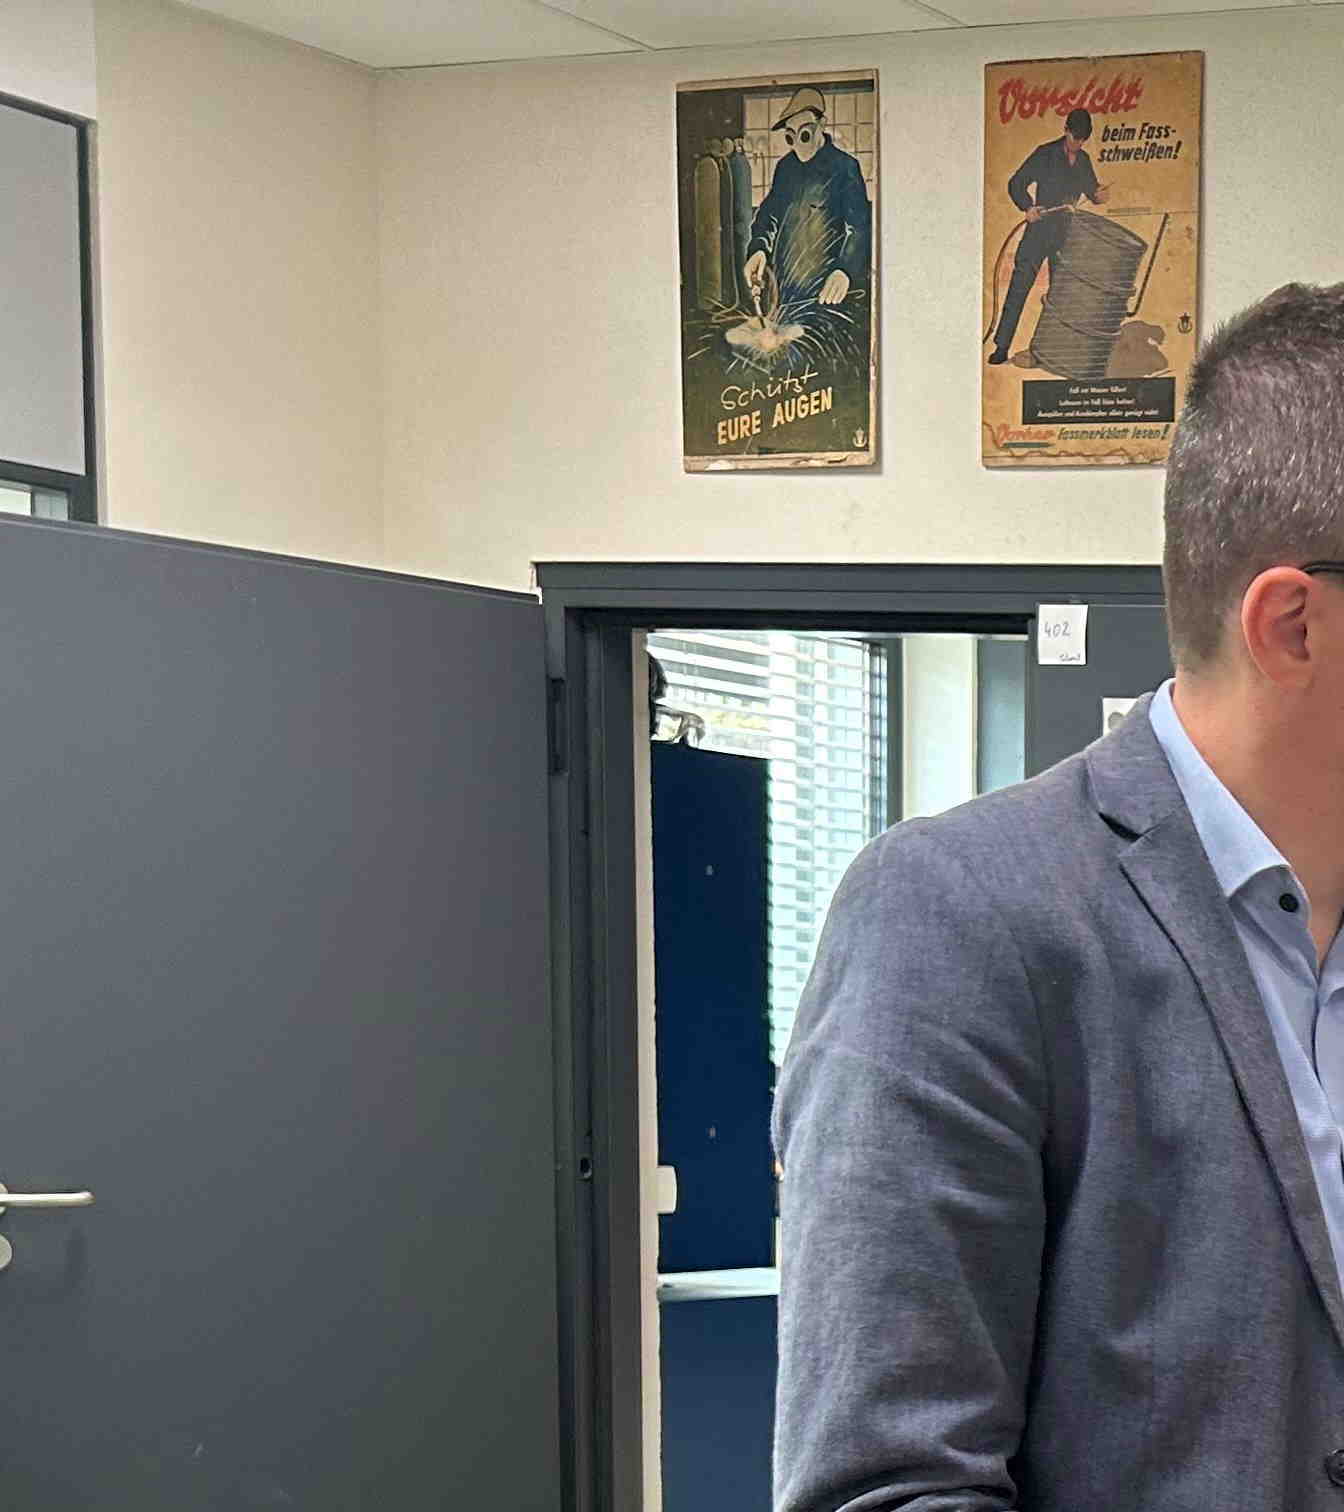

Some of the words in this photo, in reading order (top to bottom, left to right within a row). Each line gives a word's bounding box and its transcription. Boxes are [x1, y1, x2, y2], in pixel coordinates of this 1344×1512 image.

[997, 72, 1143, 125] Vorsicht
[1098, 141, 1182, 163] schweißen!
[1101, 123, 1136, 142] beim
[1138, 121, 1177, 140] Fass-
[720, 363, 818, 410] Schützt
[718, 410, 761, 445] EURE
[771, 386, 833, 428] AUGEN
